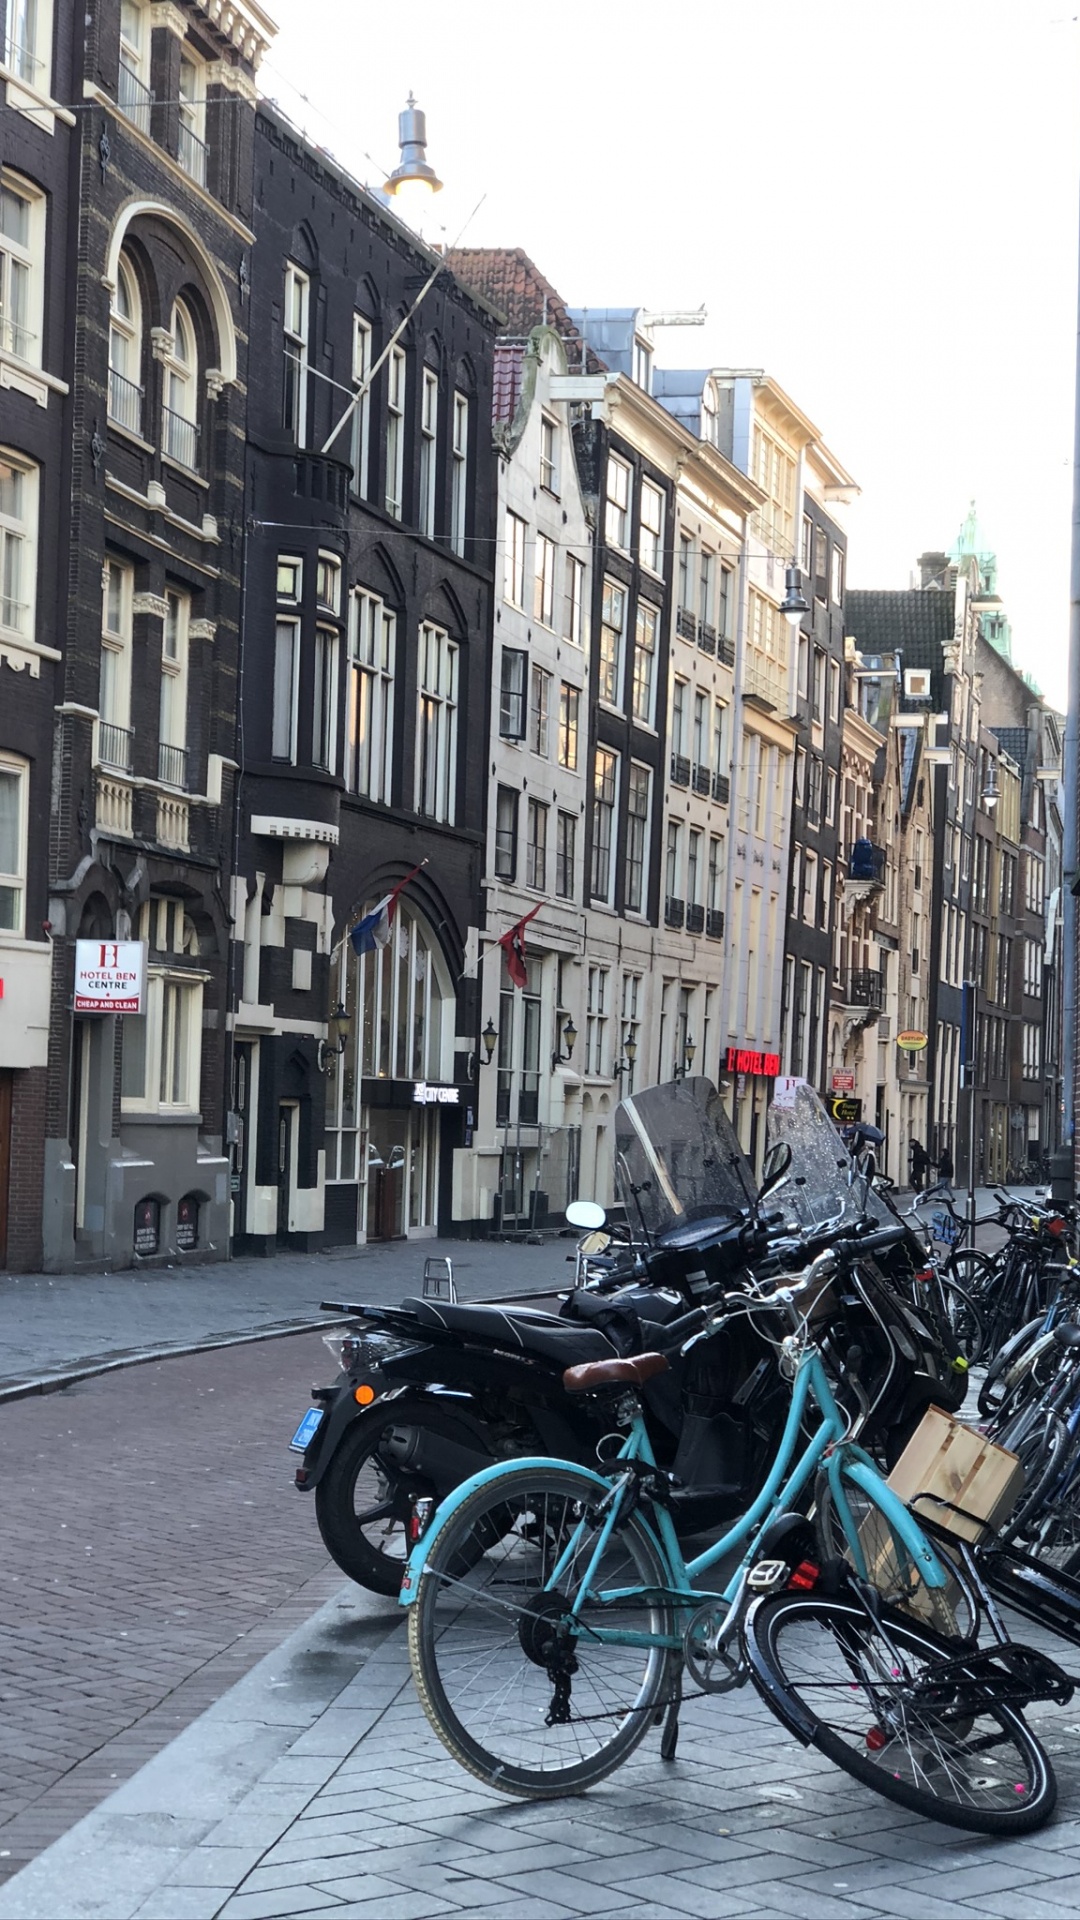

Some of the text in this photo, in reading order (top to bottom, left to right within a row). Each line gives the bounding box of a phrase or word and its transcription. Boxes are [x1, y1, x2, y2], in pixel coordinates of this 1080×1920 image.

[80, 971, 137, 981] HOTEL BEN
[88, 980, 127, 989] CENTRE
[77, 1000, 137, 1010] CHEAP AND CLEAN
[737, 1050, 762, 1075] HOTEL
[764, 1053, 780, 1077] BEN
